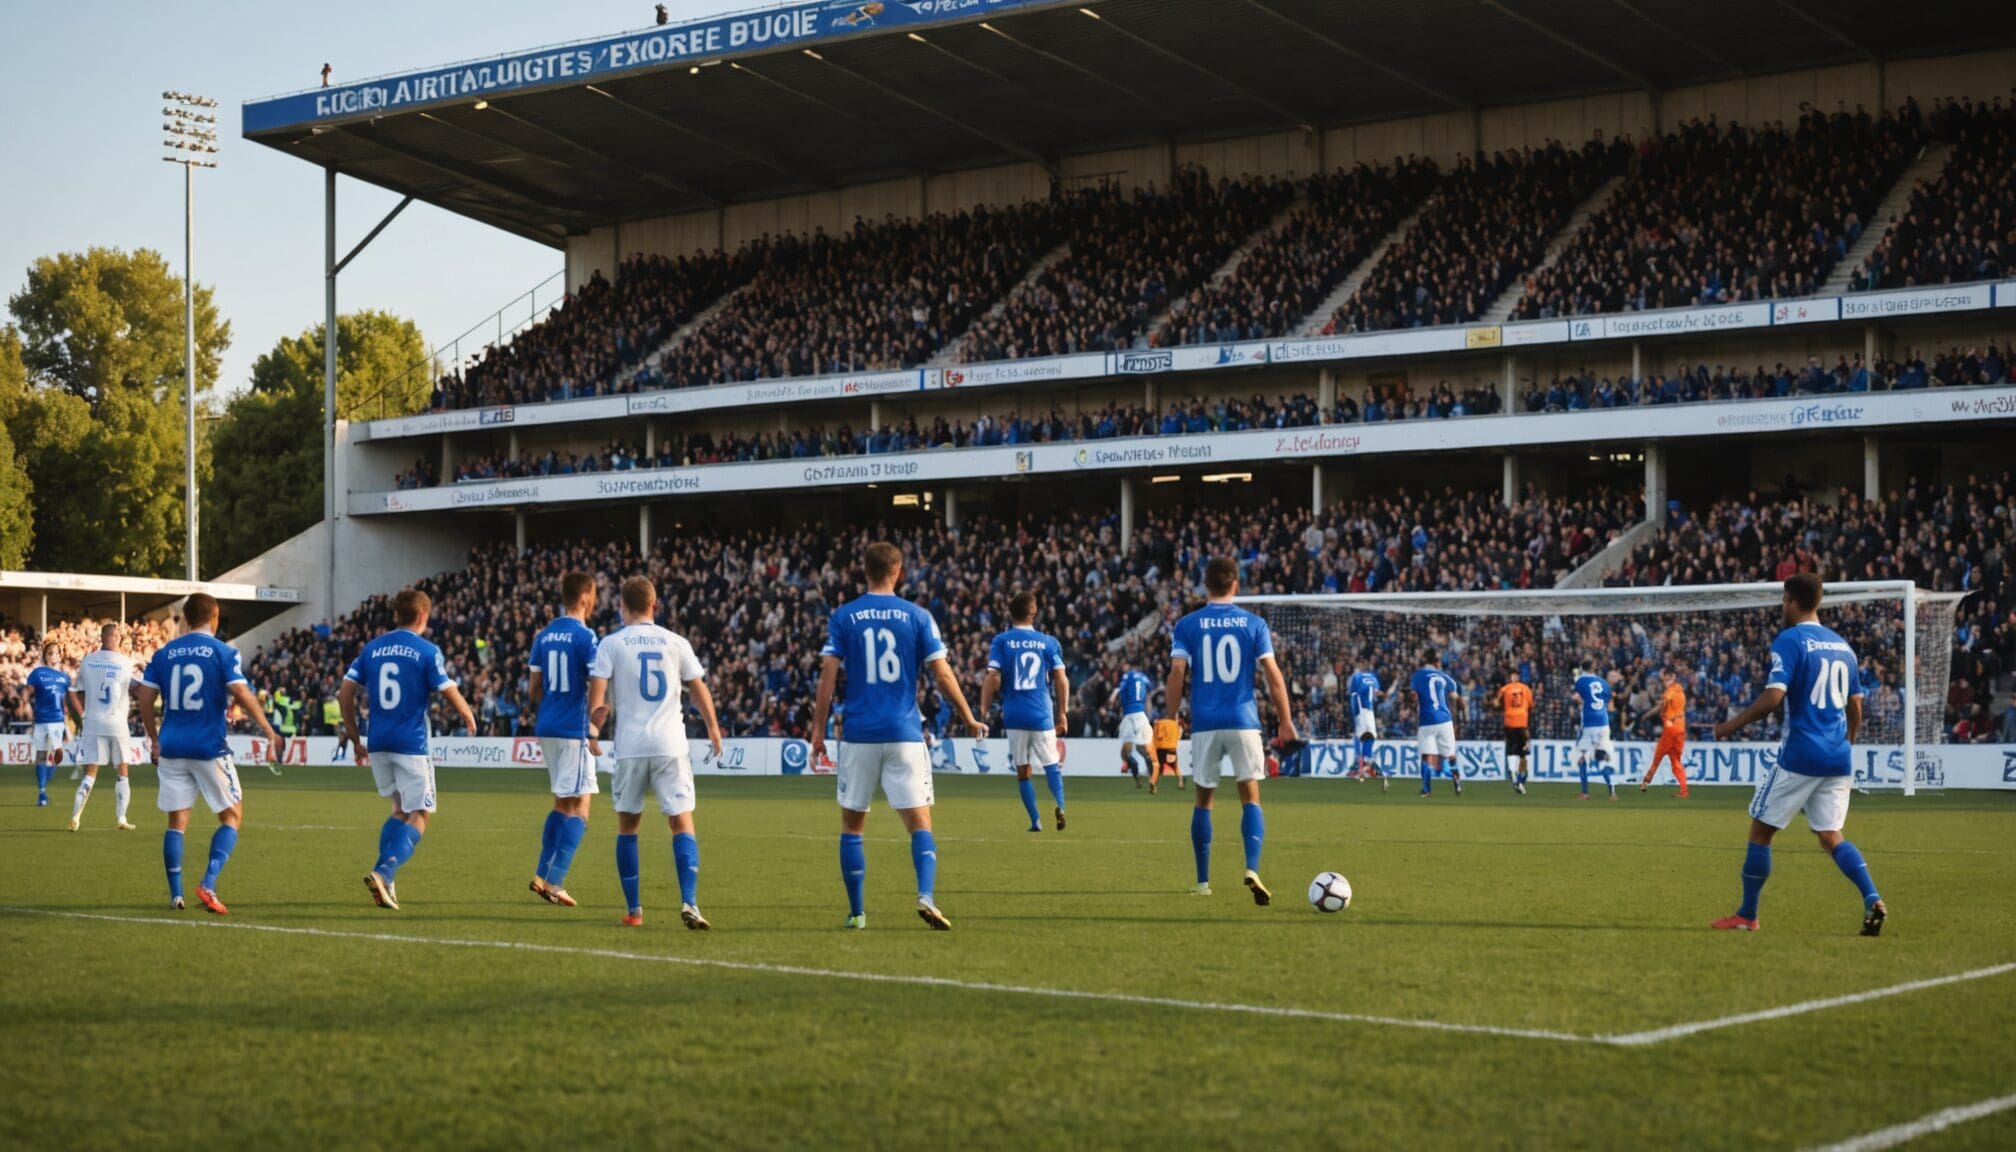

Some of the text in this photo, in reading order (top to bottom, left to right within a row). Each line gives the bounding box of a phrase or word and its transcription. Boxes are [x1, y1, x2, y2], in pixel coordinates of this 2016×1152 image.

[547, 649, 571, 693] 11
[1202, 632, 1242, 684] 10
[169, 663, 205, 711] 12
[378, 661, 402, 711] 6
